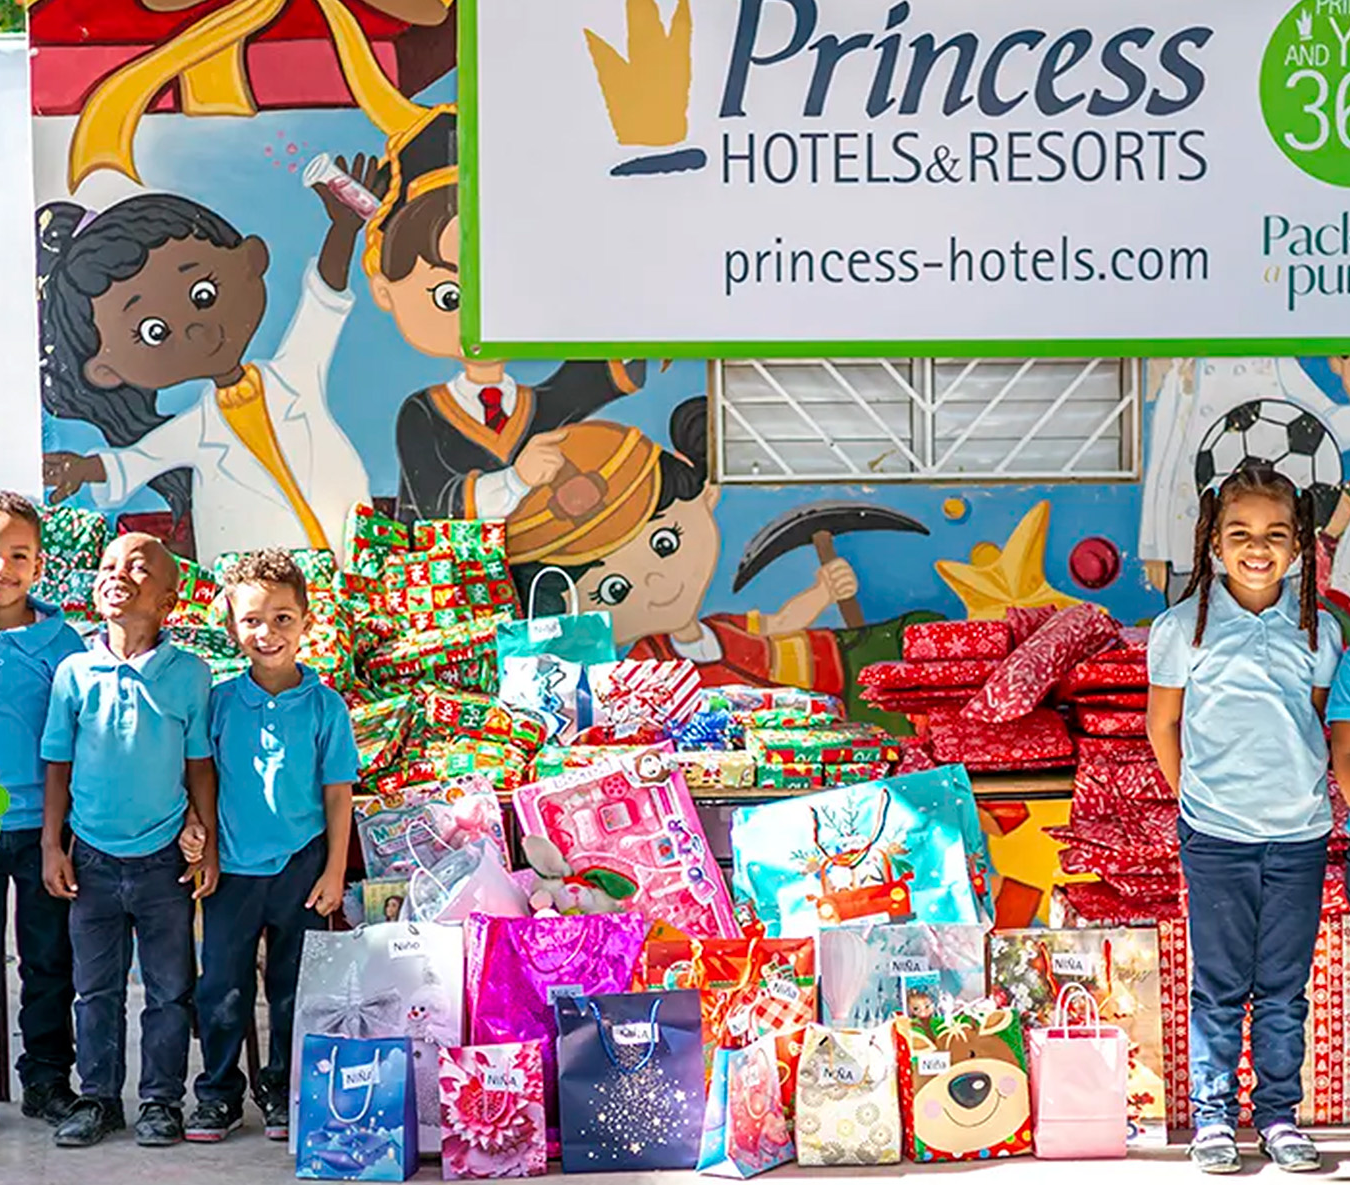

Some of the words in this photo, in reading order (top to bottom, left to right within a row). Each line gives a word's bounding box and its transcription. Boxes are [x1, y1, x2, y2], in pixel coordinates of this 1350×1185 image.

[719, 0, 1214, 118] Princess
[1284, 44, 1331, 67] AND
[724, 236, 1209, 296] princess-hotels.com
[1263, 264, 1281, 284] a
